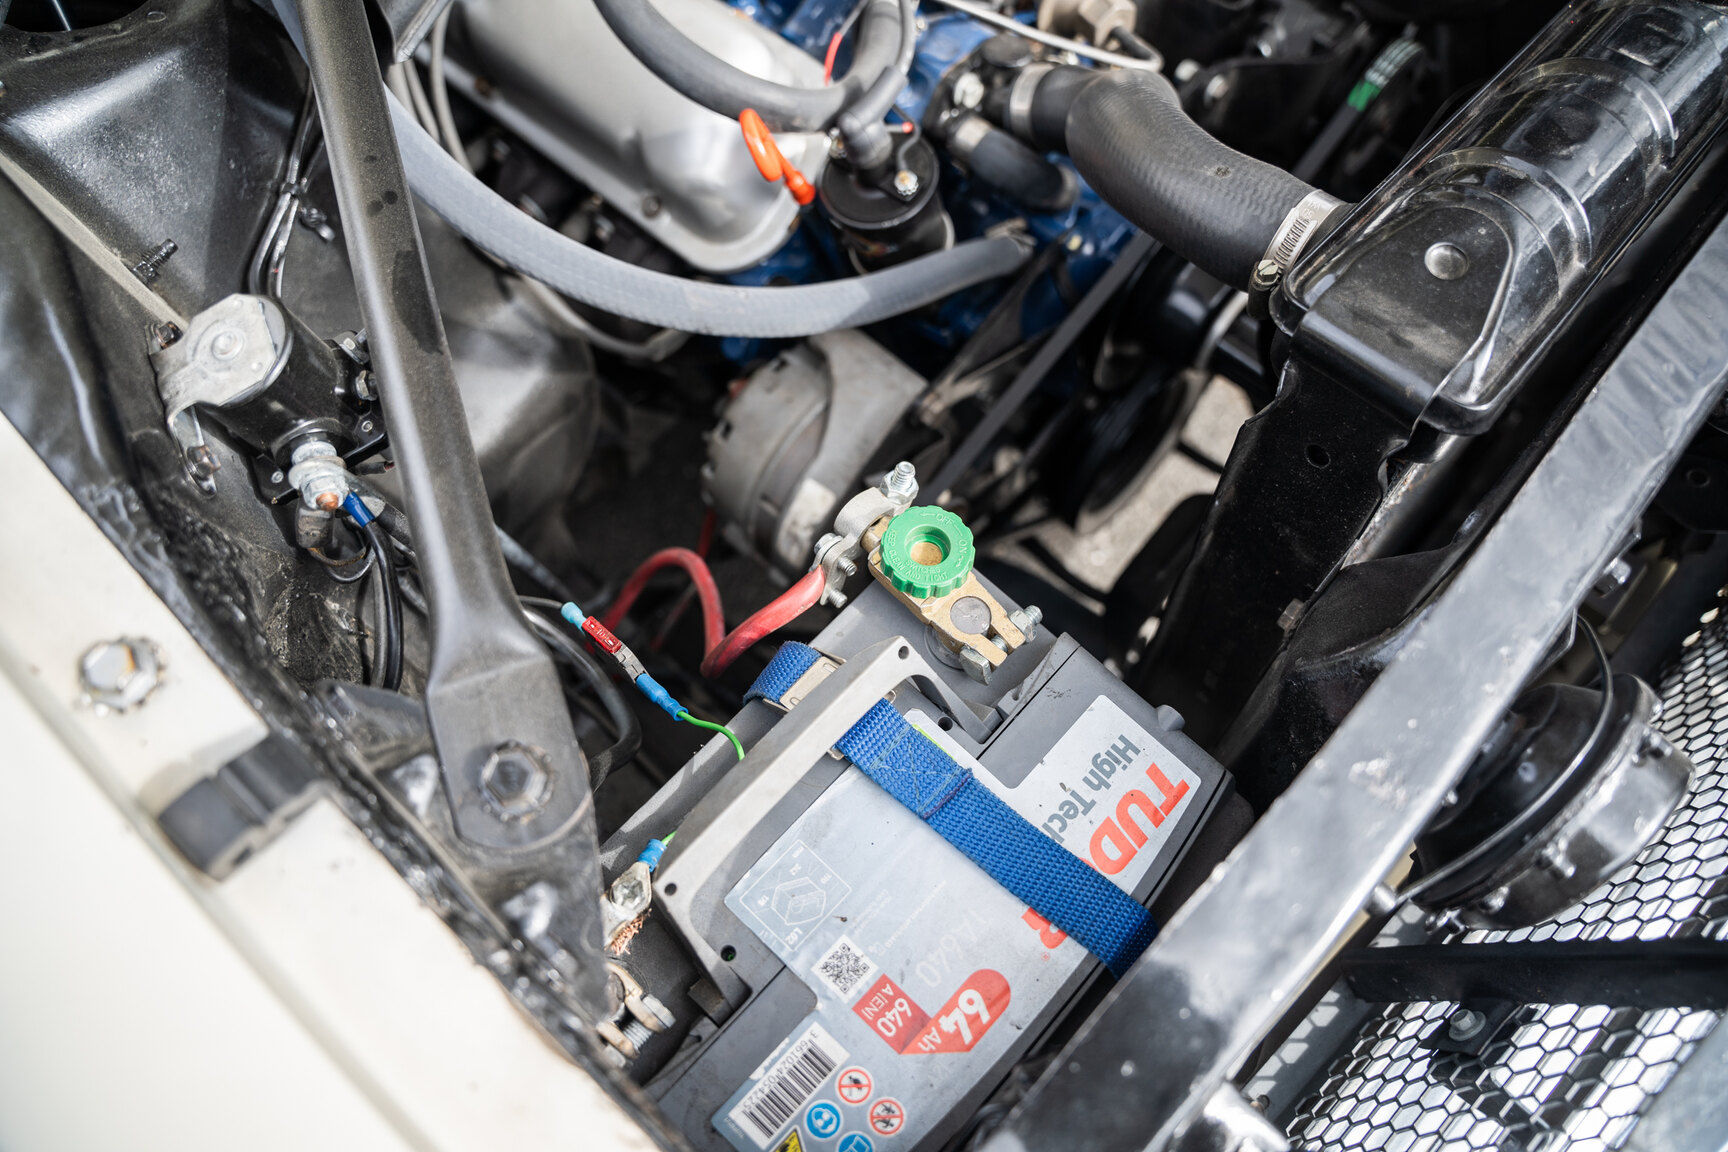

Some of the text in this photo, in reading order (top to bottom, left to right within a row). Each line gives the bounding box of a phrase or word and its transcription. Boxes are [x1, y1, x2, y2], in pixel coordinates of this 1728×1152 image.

[935, 513, 953, 525] OFF
[958, 539, 968, 554] ON
[889, 549, 906, 571] CLEAN
[905, 568, 921, 580] AND
[925, 572, 948, 581] TIGHT
[1082, 734, 1141, 791] High
[1021, 762, 1190, 949] TUDR
[881, 983, 895, 997] A
[876, 997, 913, 1038] 640
[917, 988, 991, 1052] 64 Ah
